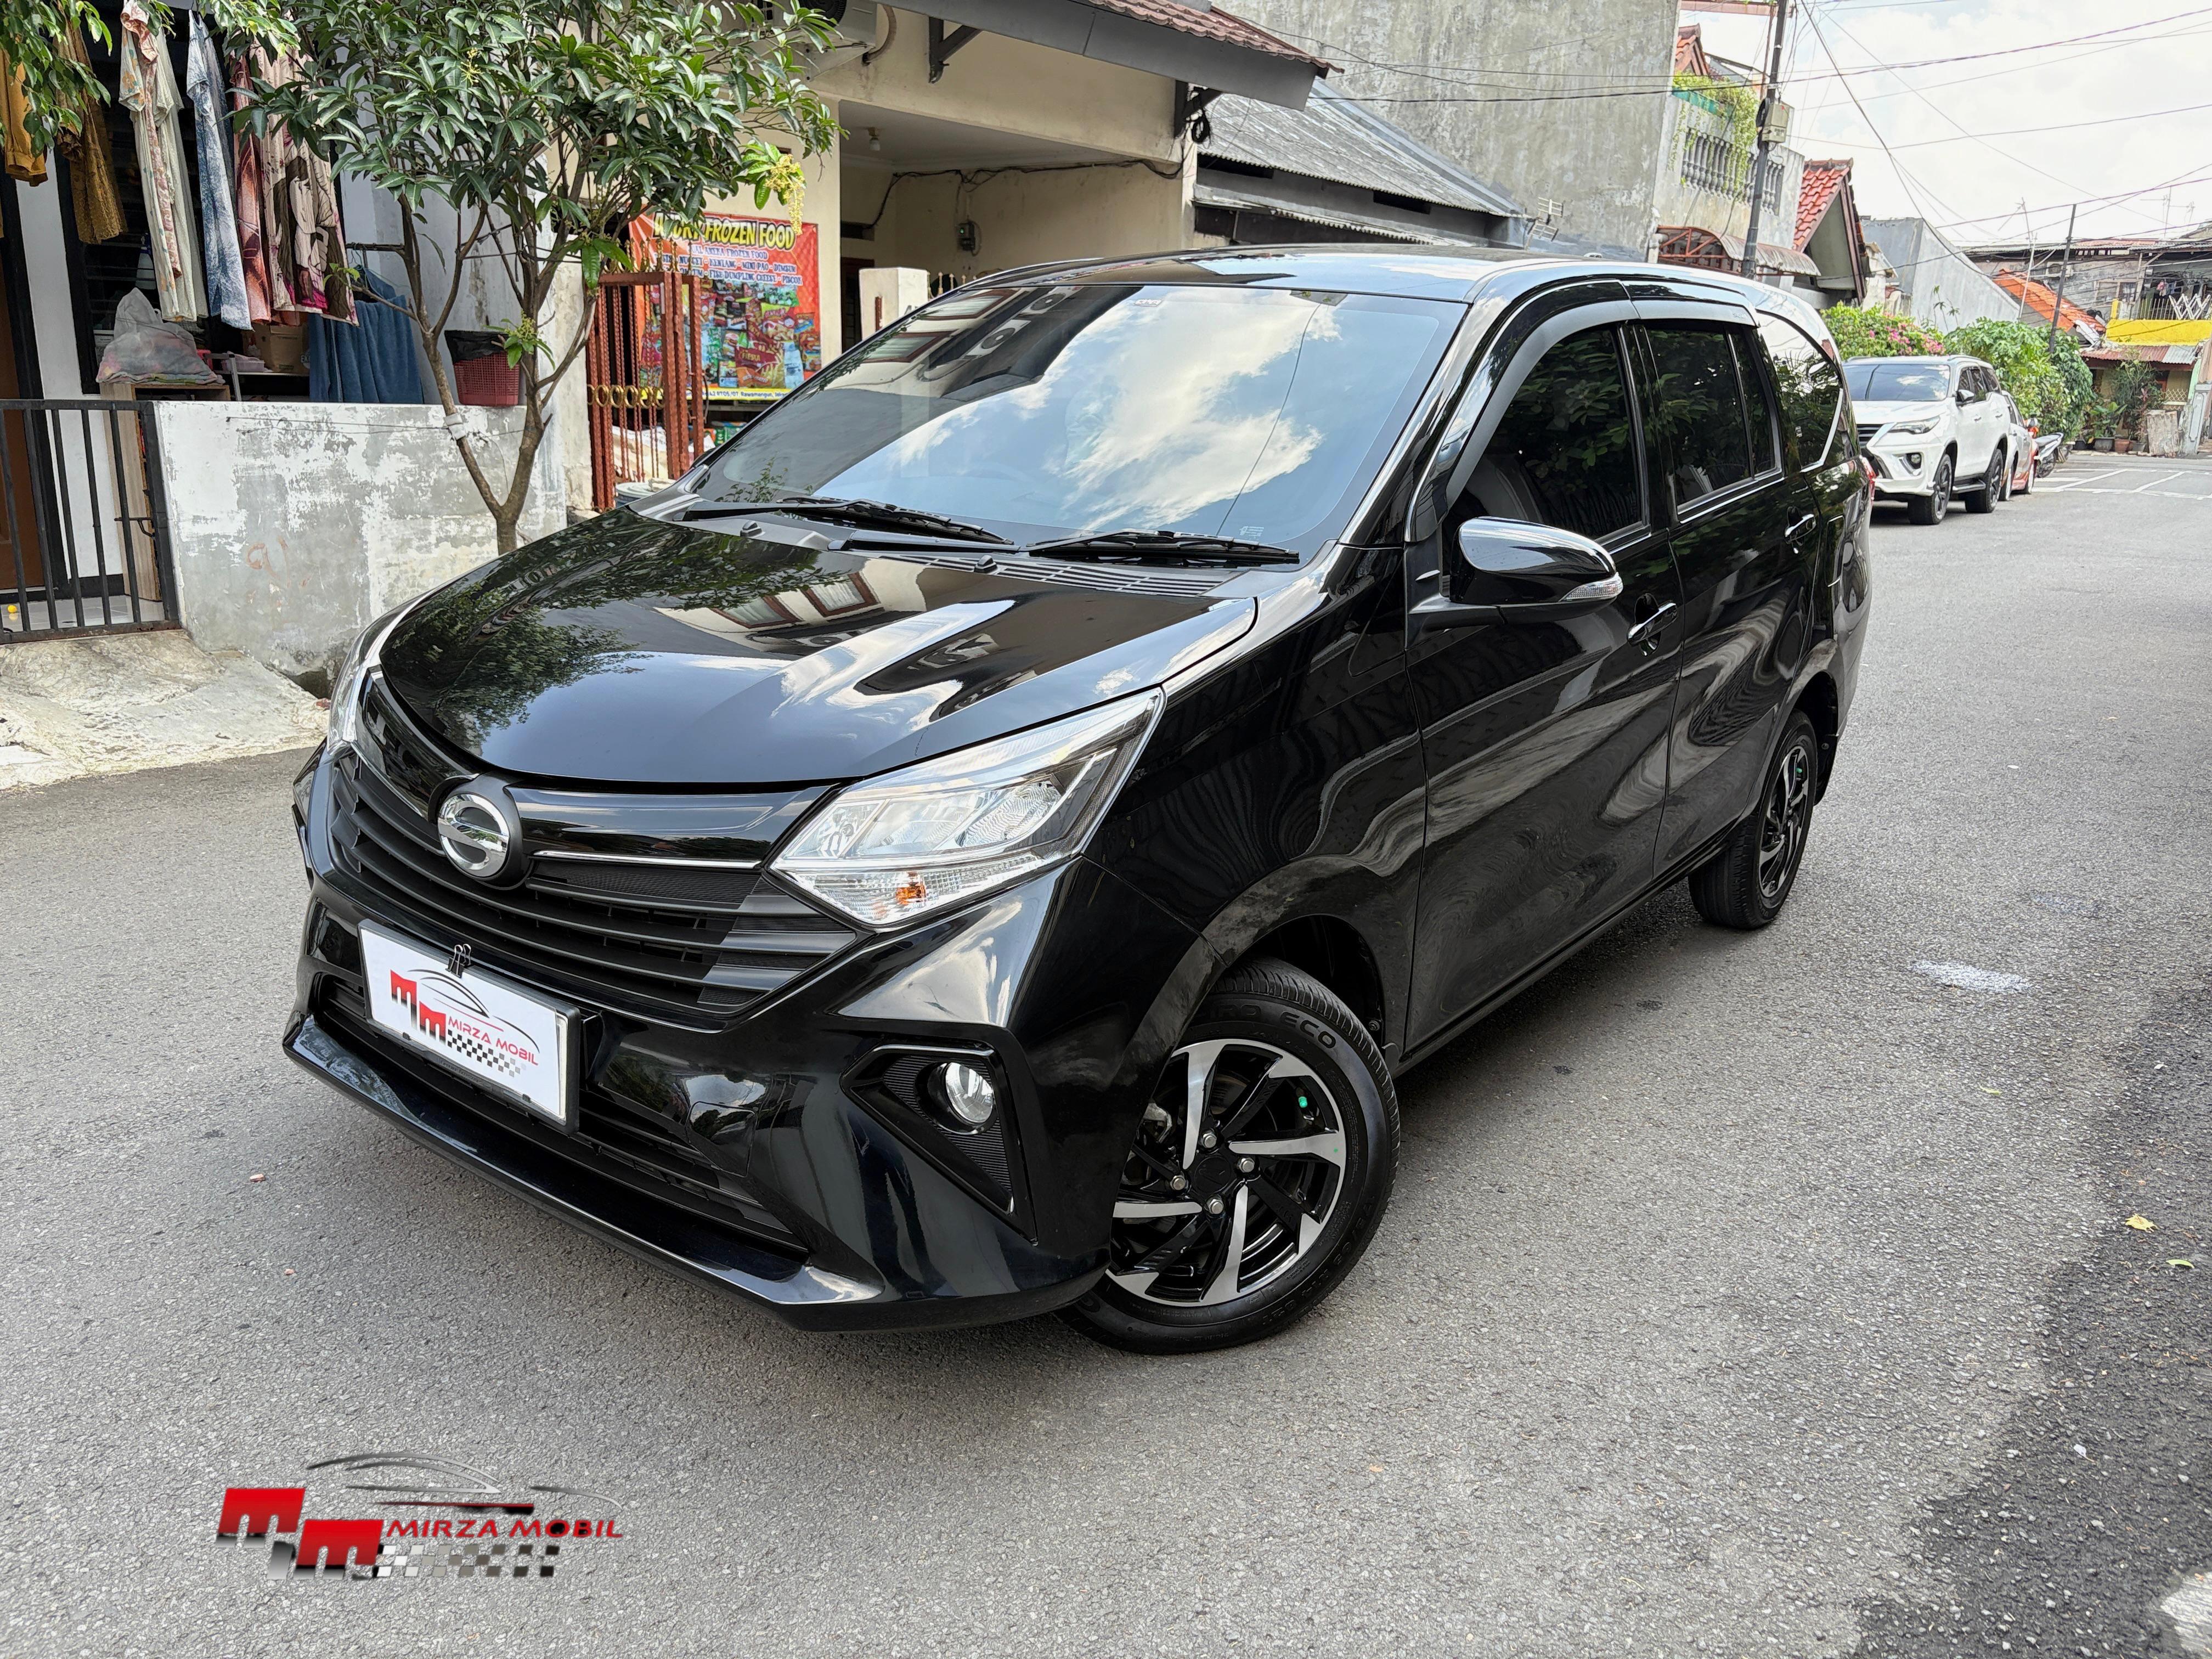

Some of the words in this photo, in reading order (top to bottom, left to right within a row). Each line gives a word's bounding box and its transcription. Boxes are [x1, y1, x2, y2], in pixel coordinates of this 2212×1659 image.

[704, 218, 757, 246] FROZEN
[759, 223, 795, 250] FOOD
[726, 249, 750, 258] FROZEN
[751, 251, 768, 259] FOOD
[757, 262, 769, 271] PAO
[448, 1015, 492, 1045] MIRZA
[495, 1037, 539, 1066] MOBIL
[1279, 1011, 1336, 1049] ECO
